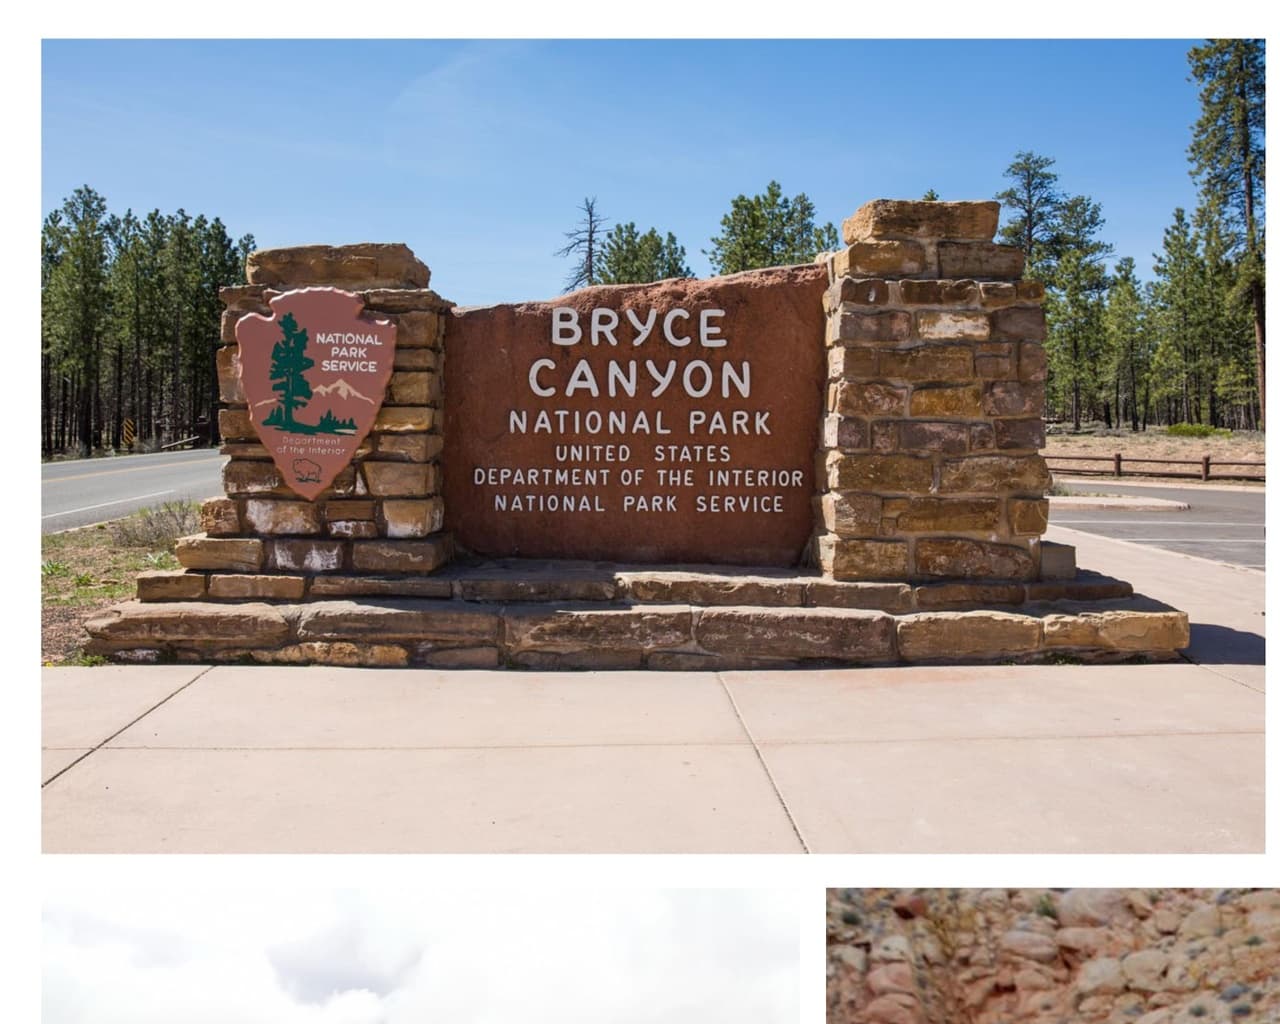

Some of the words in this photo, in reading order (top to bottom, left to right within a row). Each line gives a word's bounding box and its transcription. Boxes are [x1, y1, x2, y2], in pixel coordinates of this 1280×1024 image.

[552, 307, 728, 348] BRYCE
[316, 333, 383, 346] NATIONAL
[331, 347, 367, 359] PARK
[321, 360, 377, 373] SERVICE
[528, 358, 751, 398] CANYON
[509, 410, 671, 434] NATIONAL
[689, 410, 772, 435] PARK
[555, 445, 631, 462] UNITED
[654, 446, 731, 462] STATES
[474, 468, 610, 486] DEPARTMENT
[620, 469, 645, 486] OF
[657, 469, 694, 487] THE
[709, 470, 804, 487] INTERIOR
[494, 495, 606, 512] NATIONAL
[623, 495, 678, 513] PARK
[696, 495, 784, 513] SERVICE
